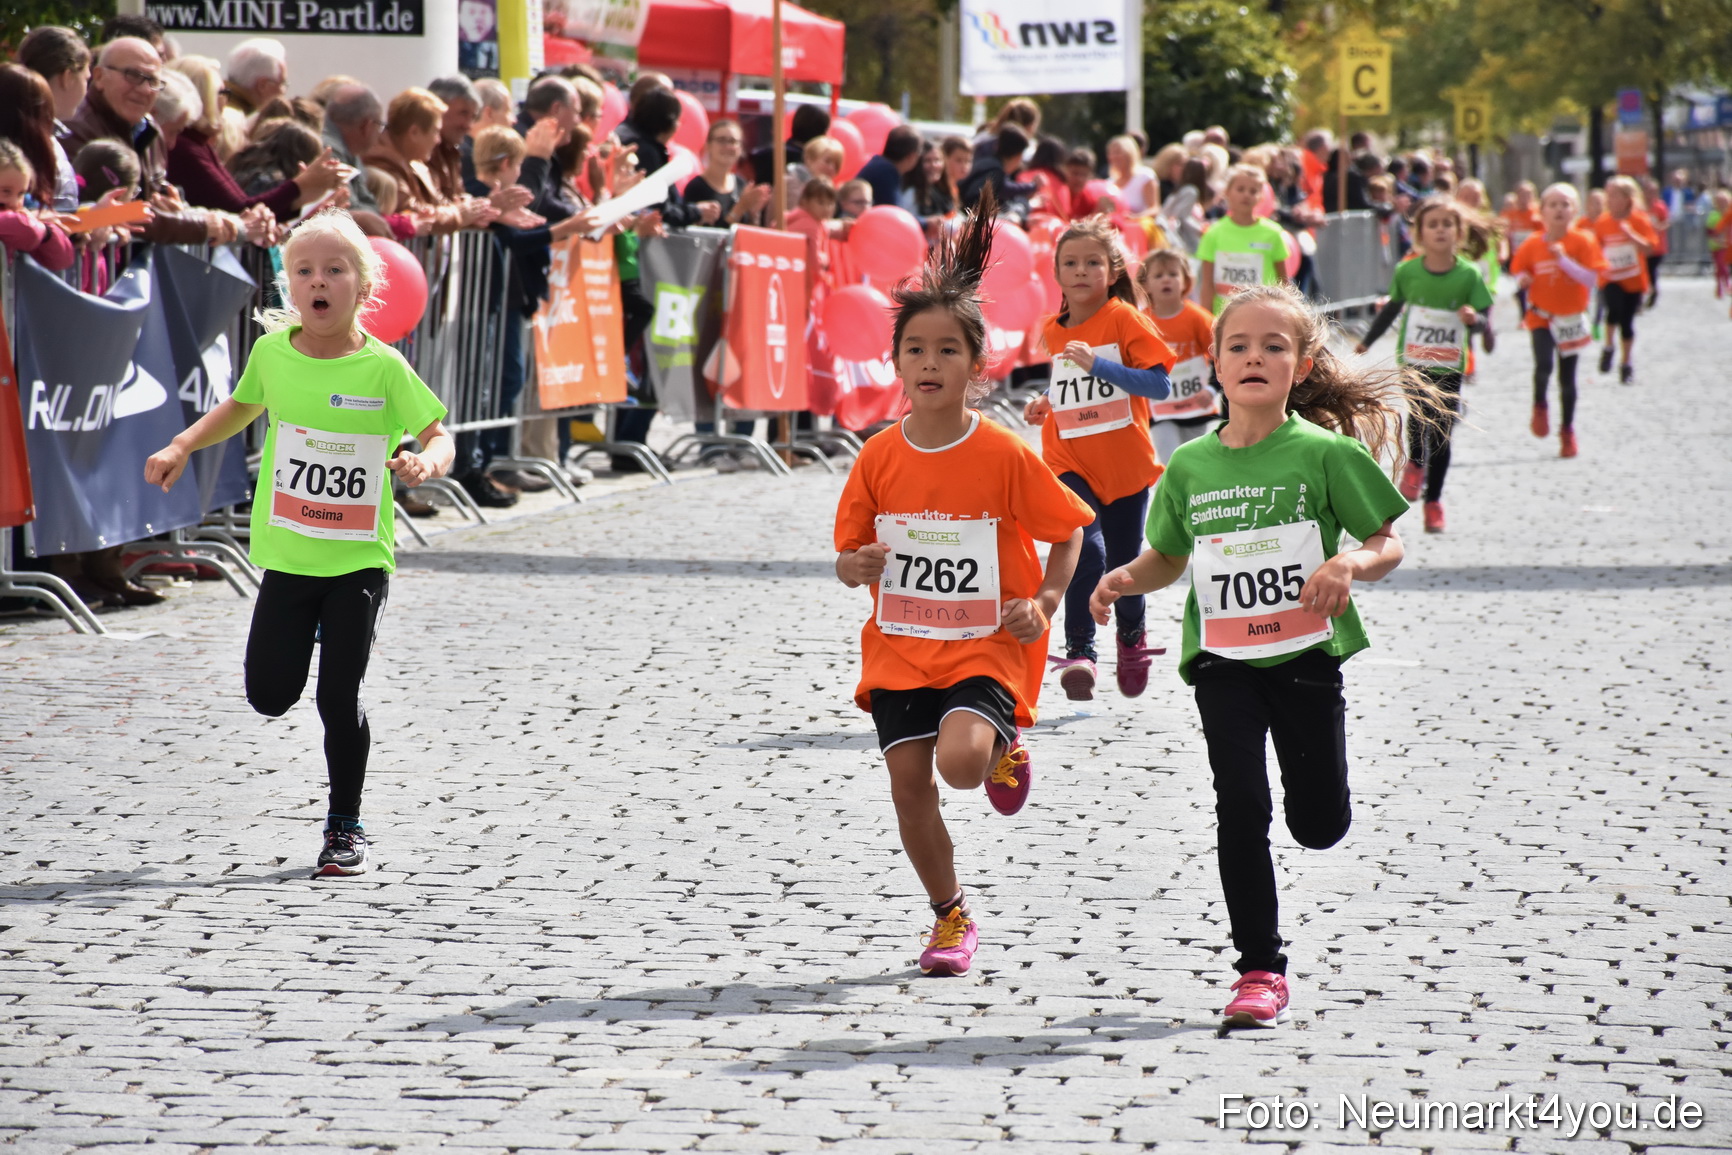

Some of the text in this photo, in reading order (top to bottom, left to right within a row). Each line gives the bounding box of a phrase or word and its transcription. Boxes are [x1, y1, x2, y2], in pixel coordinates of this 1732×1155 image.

[1353, 63, 1377, 98] C
[1463, 107, 1481, 131] D
[1221, 266, 1257, 283] 7053
[1415, 325, 1457, 344] 7204
[1057, 376, 1114, 406] 7178
[1078, 410, 1099, 421] Julia
[317, 441, 356, 453] BOCK
[289, 457, 367, 499] 7036
[1190, 485, 1266, 508] Neumarkter
[301, 505, 343, 521] Cosima
[1191, 502, 1250, 526] Stadtlauf
[918, 530, 960, 542] BOCK
[1234, 537, 1282, 556] BOCK
[895, 553, 979, 594] 7262
[1211, 563, 1306, 611] 7085
[900, 600, 970, 621] Fiona
[1247, 621, 1281, 636] Anna
